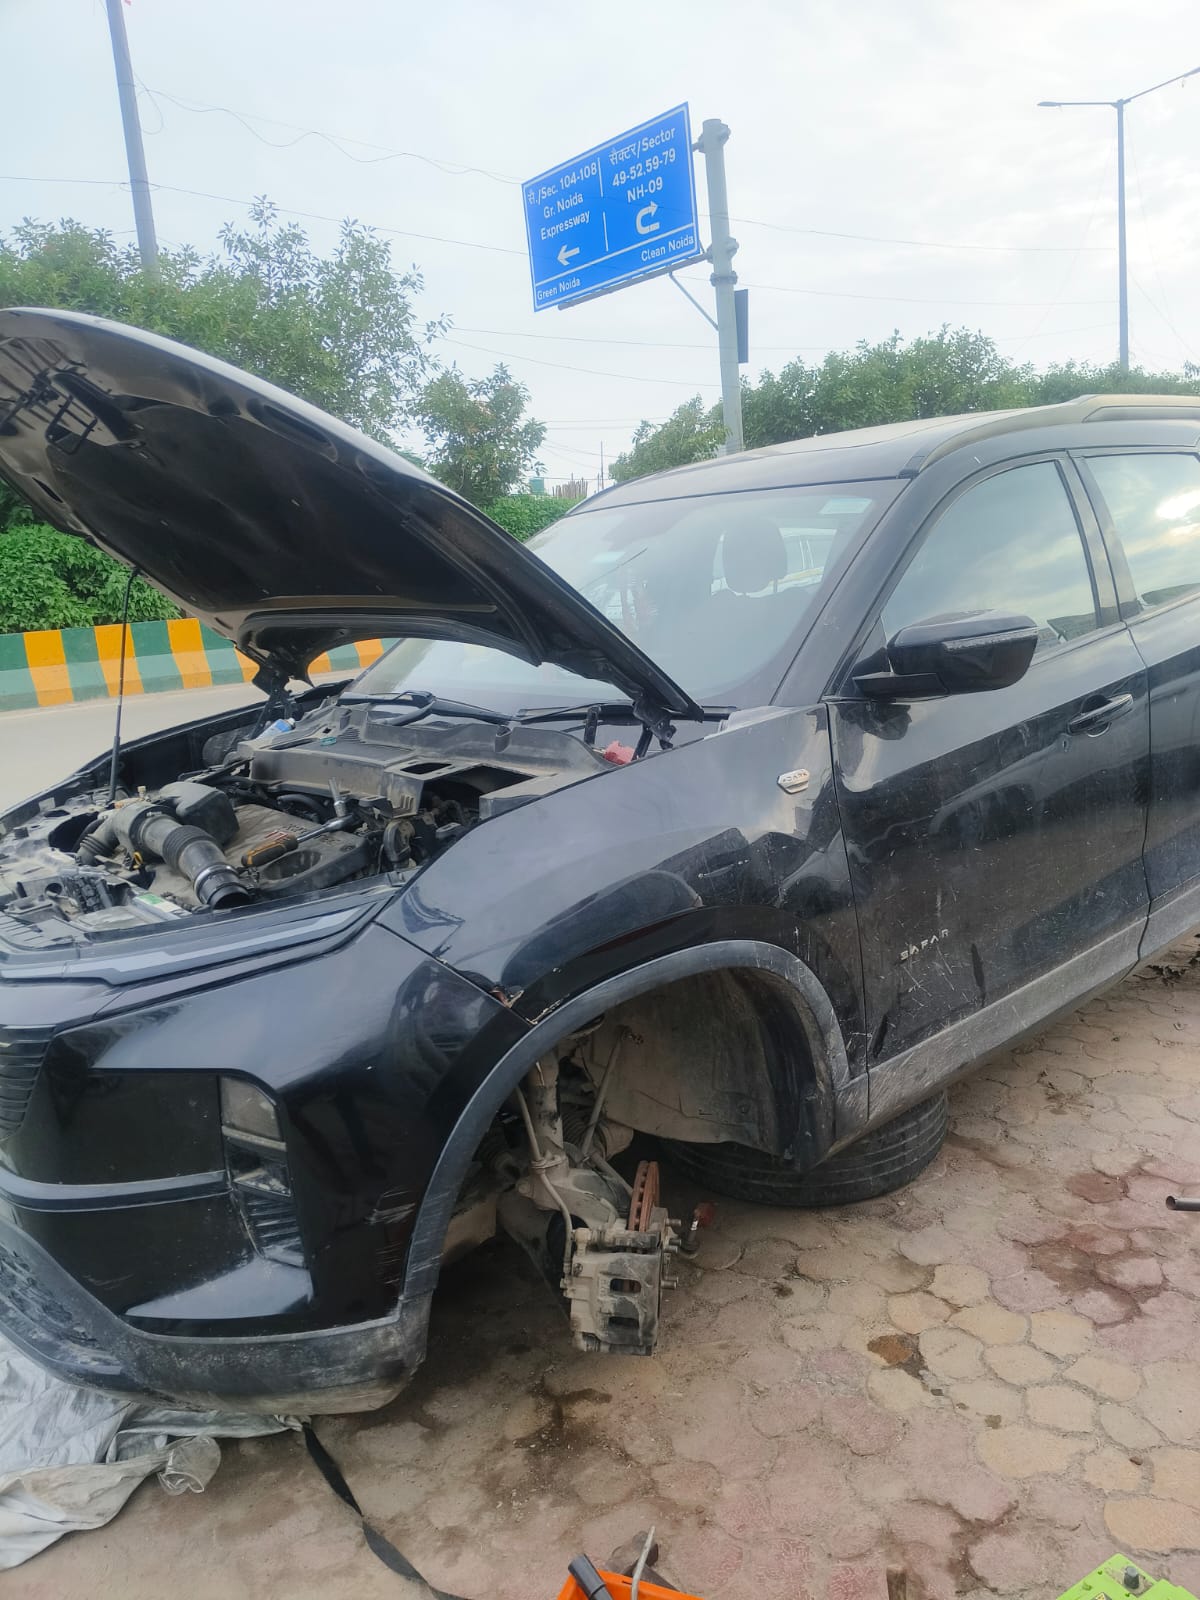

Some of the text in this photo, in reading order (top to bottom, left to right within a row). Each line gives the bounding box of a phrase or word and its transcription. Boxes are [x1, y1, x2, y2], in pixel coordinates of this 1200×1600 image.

[560, 162, 598, 190] 104-108
[627, 176, 663, 203] NH-09
[543, 192, 584, 219] Gr. Noida
[540, 210, 590, 240] Expressway
[641, 234, 694, 262] Clean Noida
[537, 277, 581, 300] Green Noida
